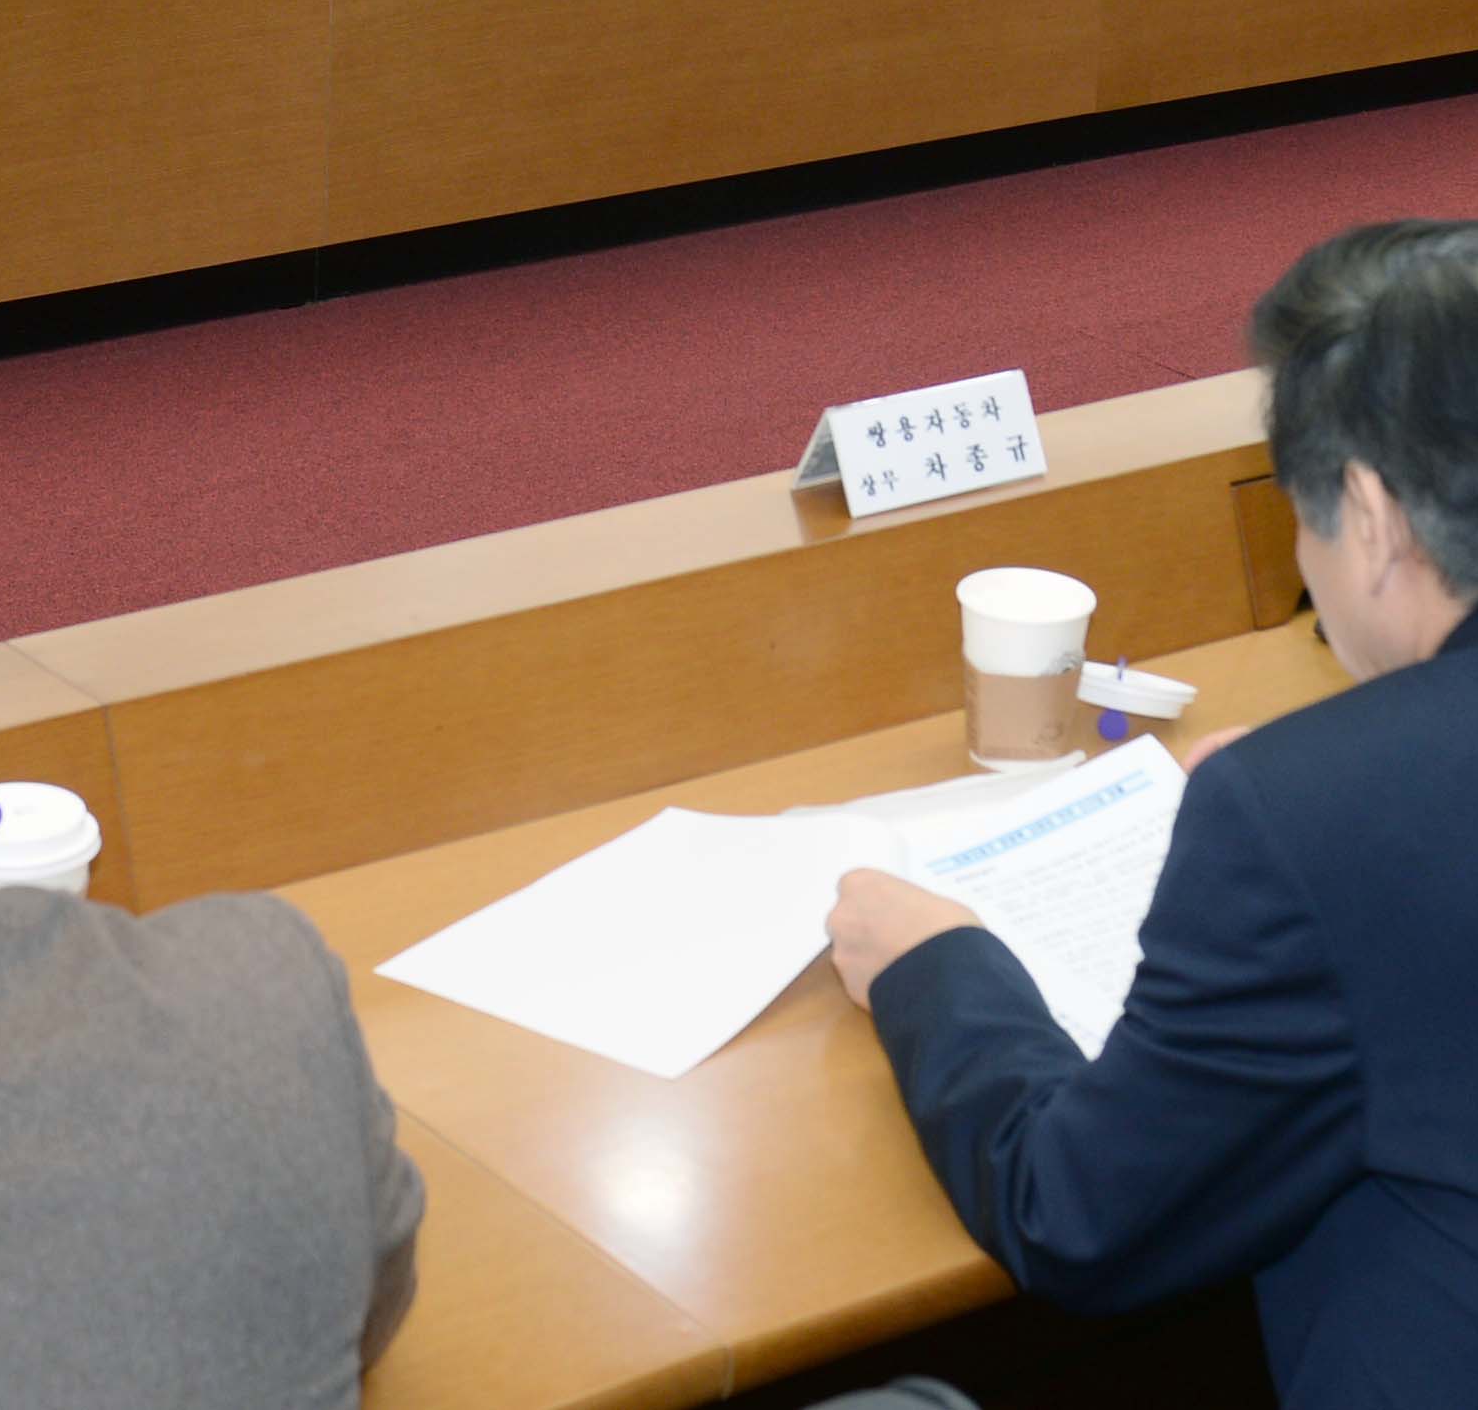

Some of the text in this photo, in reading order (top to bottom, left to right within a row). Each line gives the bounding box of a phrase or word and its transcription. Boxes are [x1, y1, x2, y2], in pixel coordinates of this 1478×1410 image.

[867, 395, 1002, 448] 쌍용자동차
[861, 434, 1029, 496] 상무 차종규
